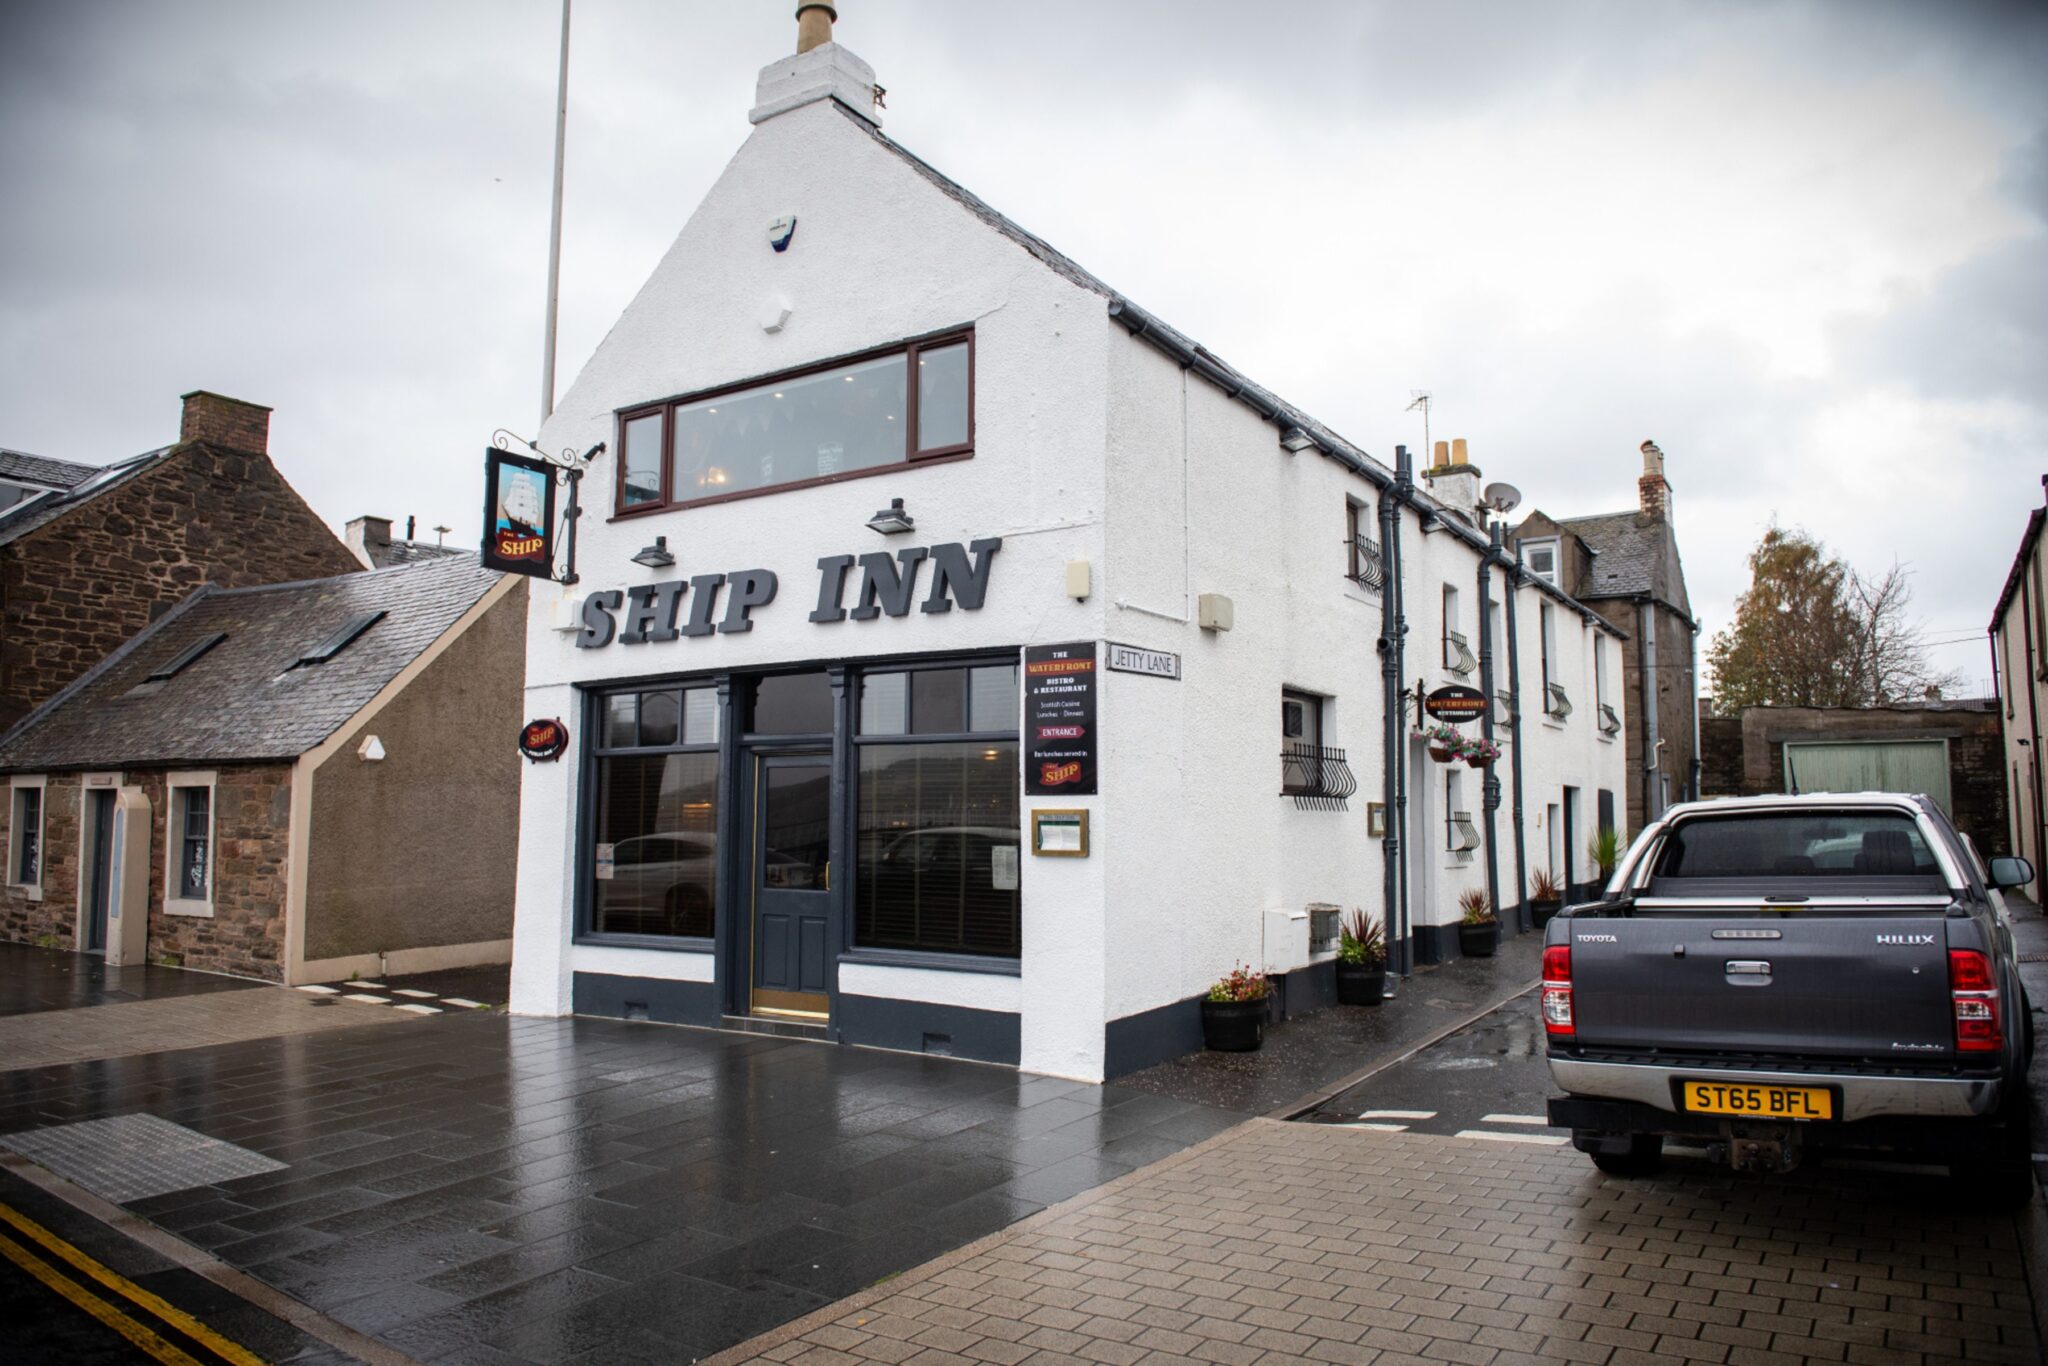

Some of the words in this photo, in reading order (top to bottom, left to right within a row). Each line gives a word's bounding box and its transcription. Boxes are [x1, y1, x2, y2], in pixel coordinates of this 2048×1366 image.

[501, 538, 543, 555] SHIP
[575, 568, 779, 649] SHIP
[808, 536, 1003, 623] INN
[1052, 651, 1069, 659] THE
[1115, 649, 1144, 670] JETTY
[1147, 654, 1172, 673] LANE
[1028, 661, 1092, 673] WATERFRONT
[1046, 677, 1075, 685] BISTRO
[1040, 685, 1087, 694] RESTAURANT
[1040, 701, 1060, 709] Scottish
[530, 727, 553, 745] SHIP
[1042, 727, 1078, 737] ENTRANCE
[1045, 763, 1078, 782] SHIP
[1577, 934, 1617, 943] TOYOTA
[1876, 934, 1935, 945] HILUX
[1696, 1086, 1761, 1111] ST65
[1769, 1089, 1820, 1115] BFL
